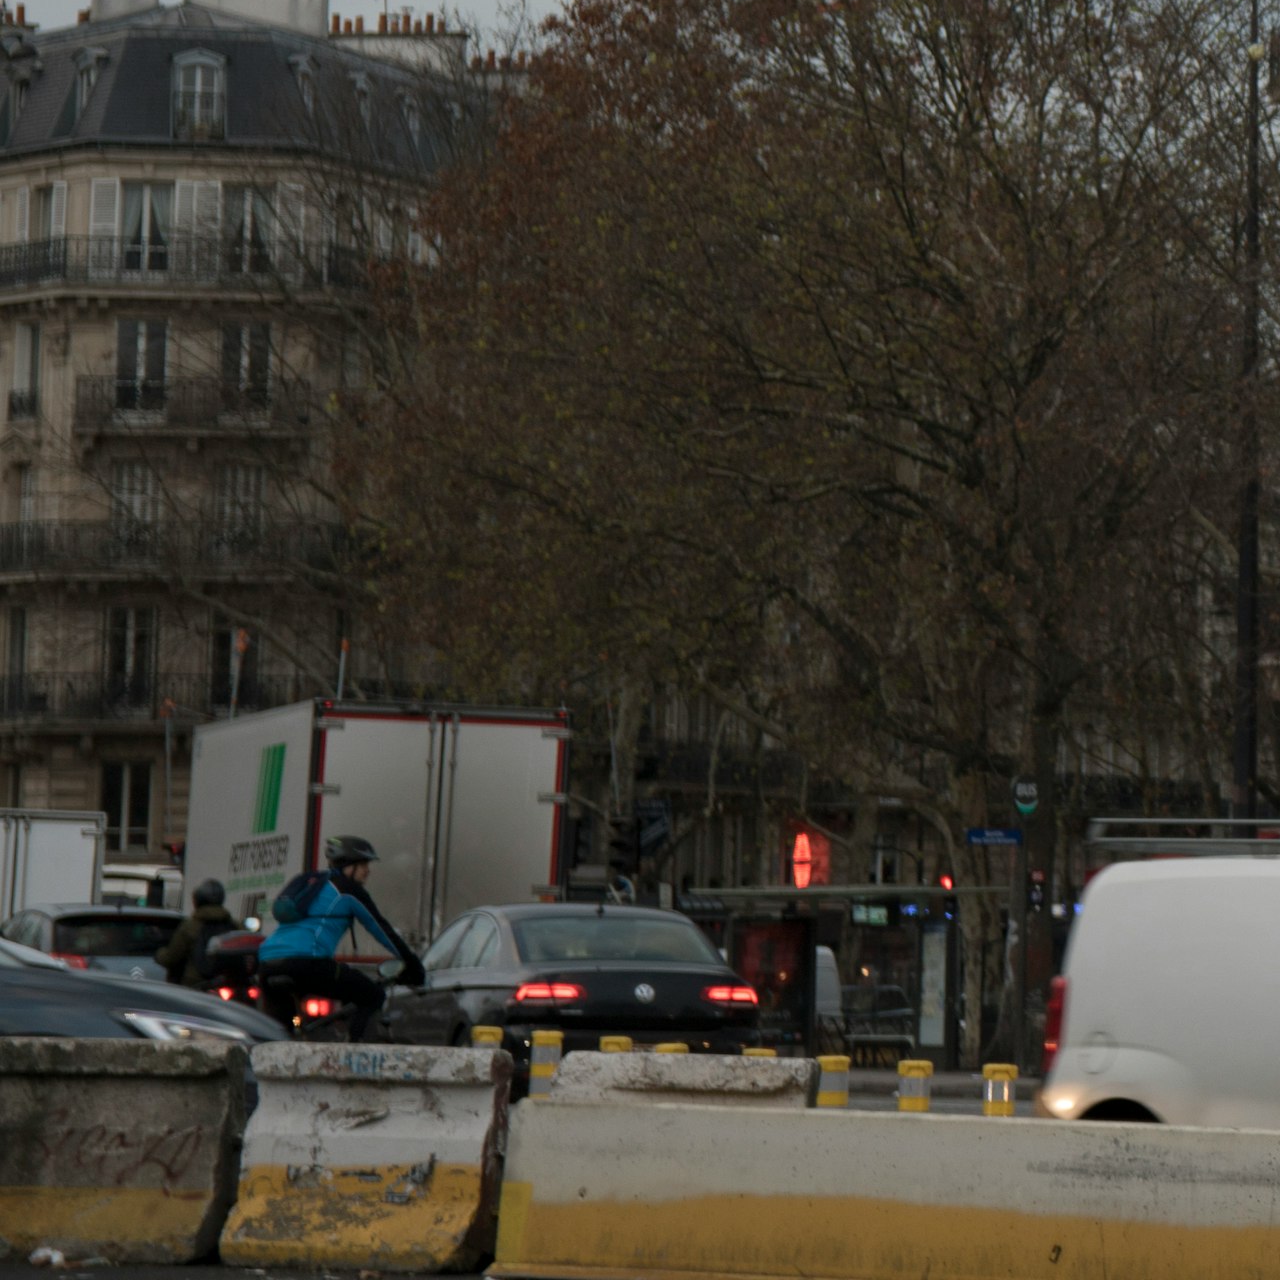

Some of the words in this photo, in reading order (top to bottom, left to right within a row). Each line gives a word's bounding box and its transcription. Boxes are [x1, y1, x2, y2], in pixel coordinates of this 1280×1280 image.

[1015, 783, 1038, 796] BUS
[229, 841, 250, 873] PETIT
[250, 834, 290, 871] FORESTIER
